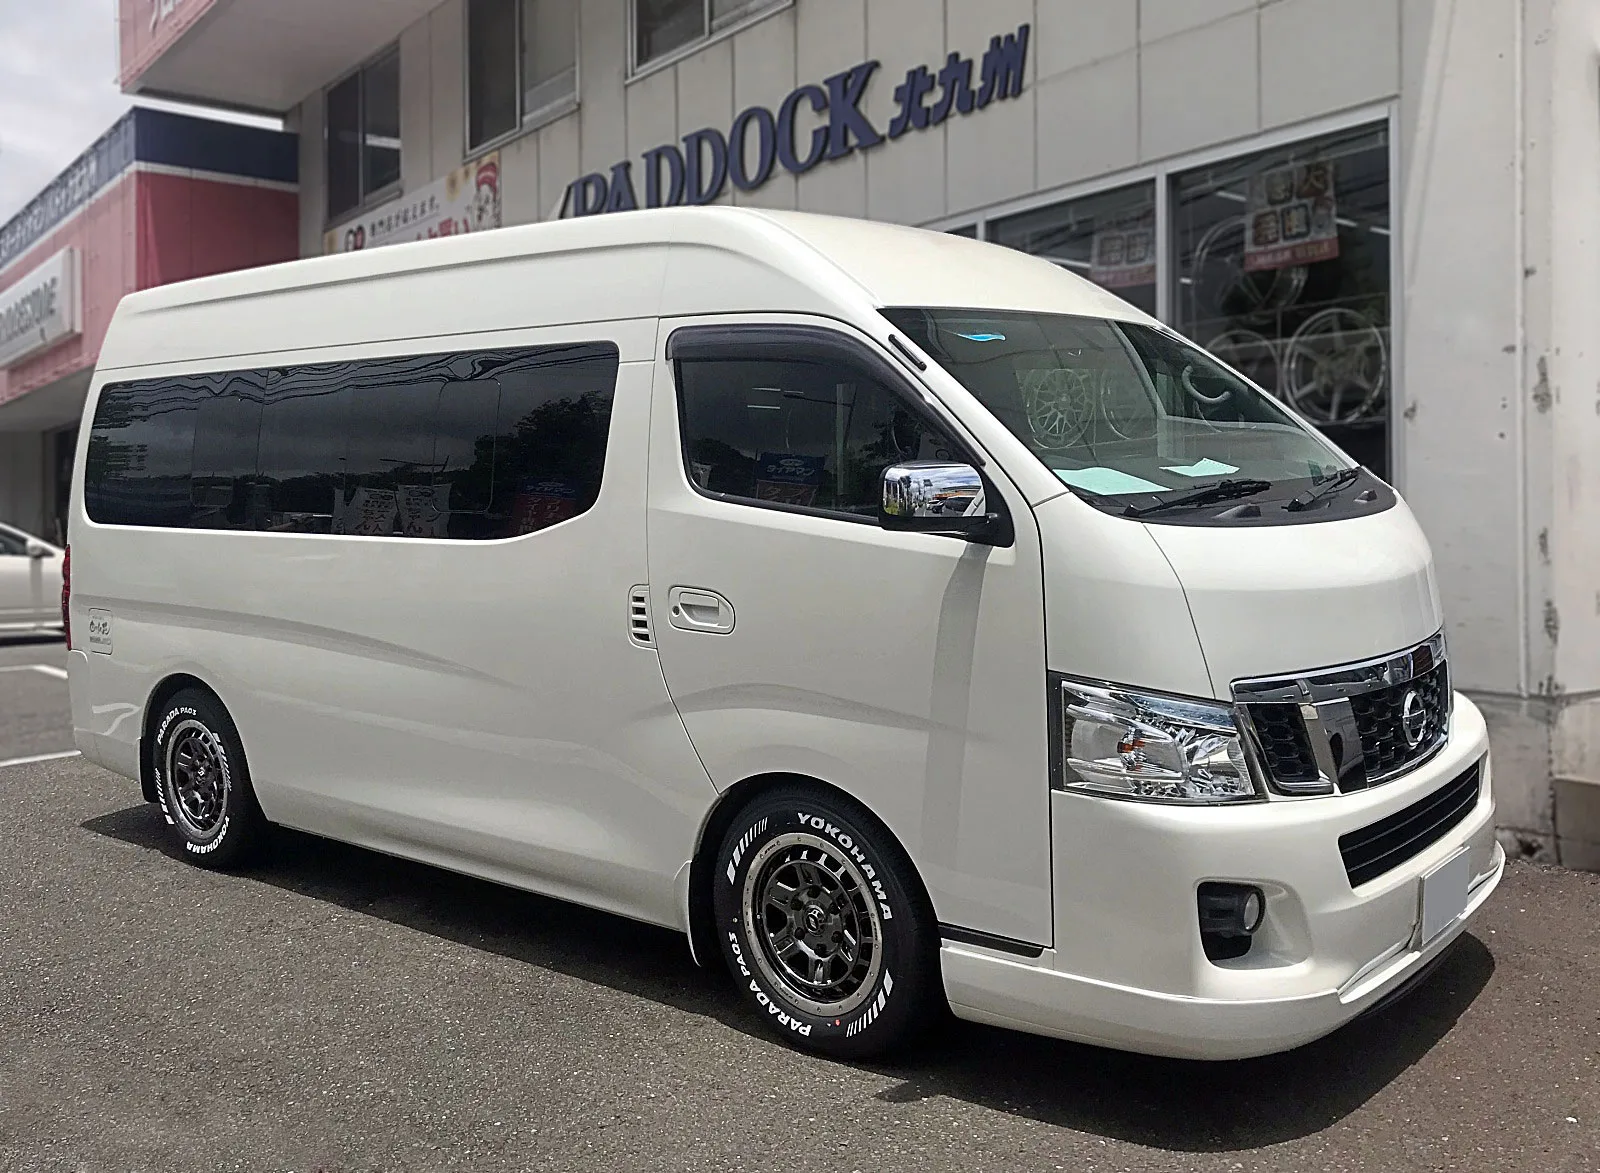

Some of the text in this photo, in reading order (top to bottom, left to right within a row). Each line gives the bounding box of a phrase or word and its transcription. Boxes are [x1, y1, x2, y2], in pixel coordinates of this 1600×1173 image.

[569, 24, 1030, 218] PADDOCK 北九州
[157, 707, 179, 745] PARADA
[186, 815, 230, 854] YOKOHAMA
[798, 812, 893, 920] YOKOHAMA
[749, 979, 813, 1037] PARADA
